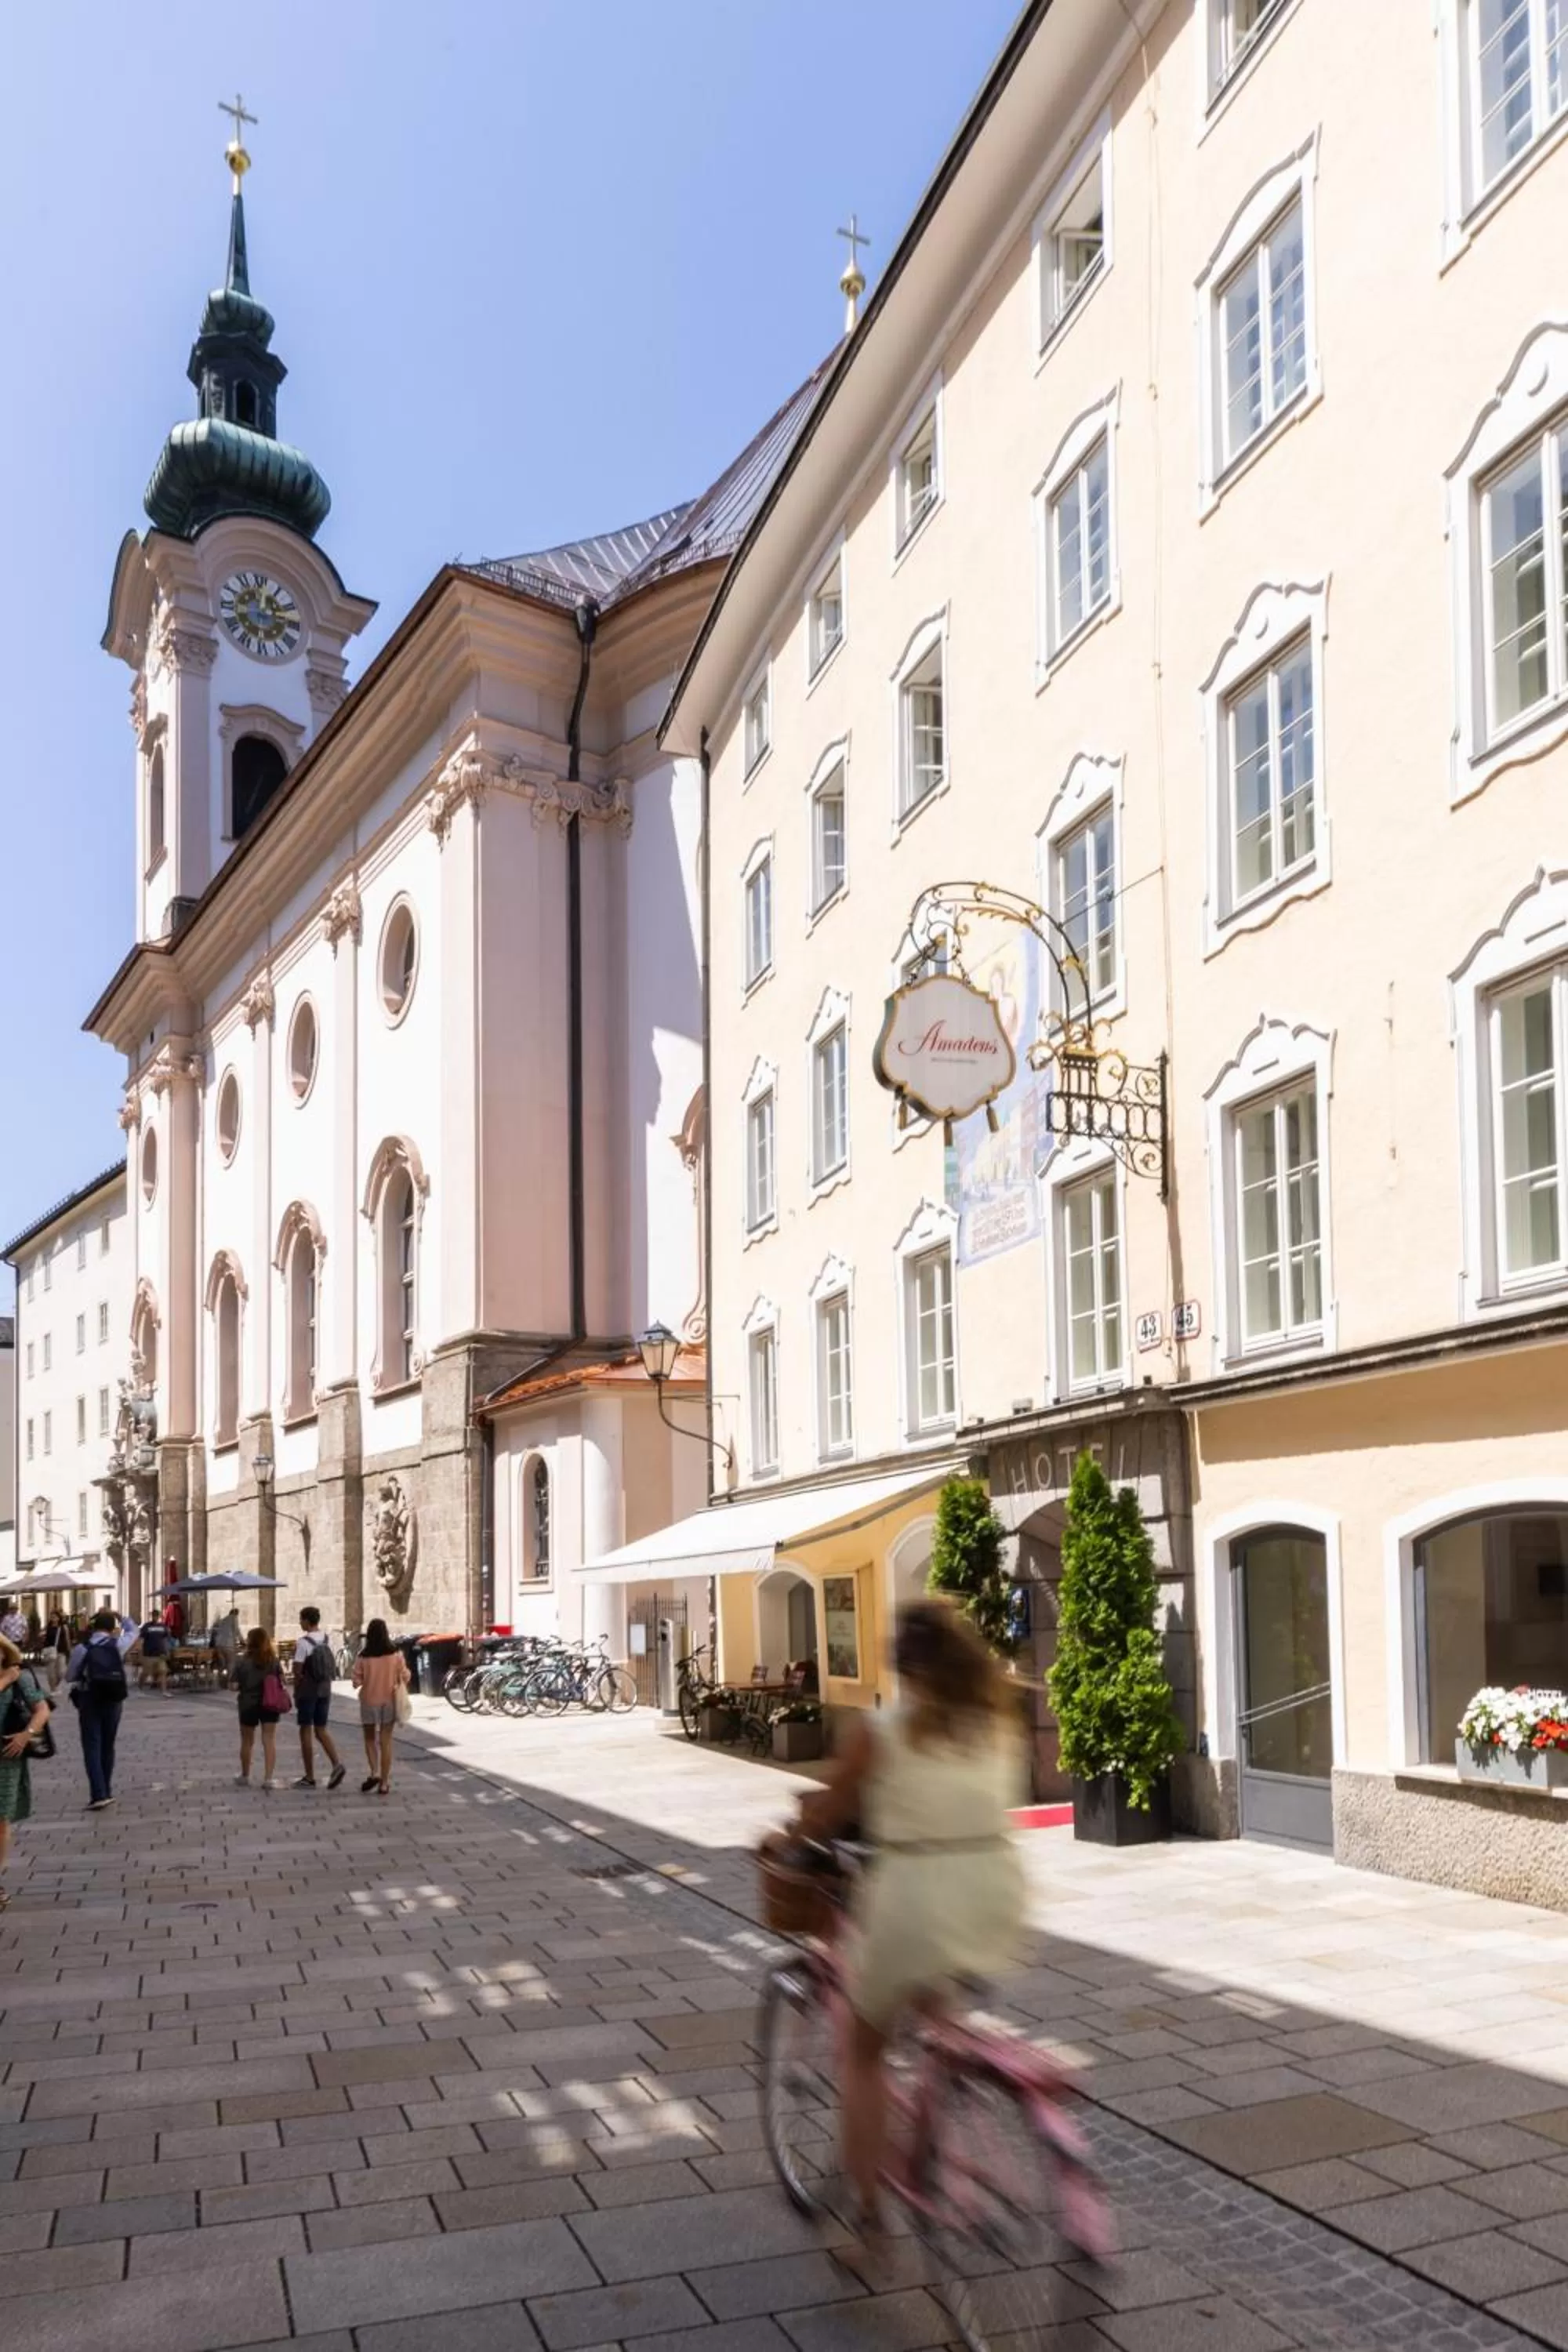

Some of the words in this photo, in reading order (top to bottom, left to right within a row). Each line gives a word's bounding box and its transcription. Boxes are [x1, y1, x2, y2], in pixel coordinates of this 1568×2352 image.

[898, 1019, 998, 1054] Amadeus
[1141, 1315, 1156, 1339] 43
[1176, 1305, 1194, 1330] 45
[1011, 1443, 1127, 1499] HOTL
